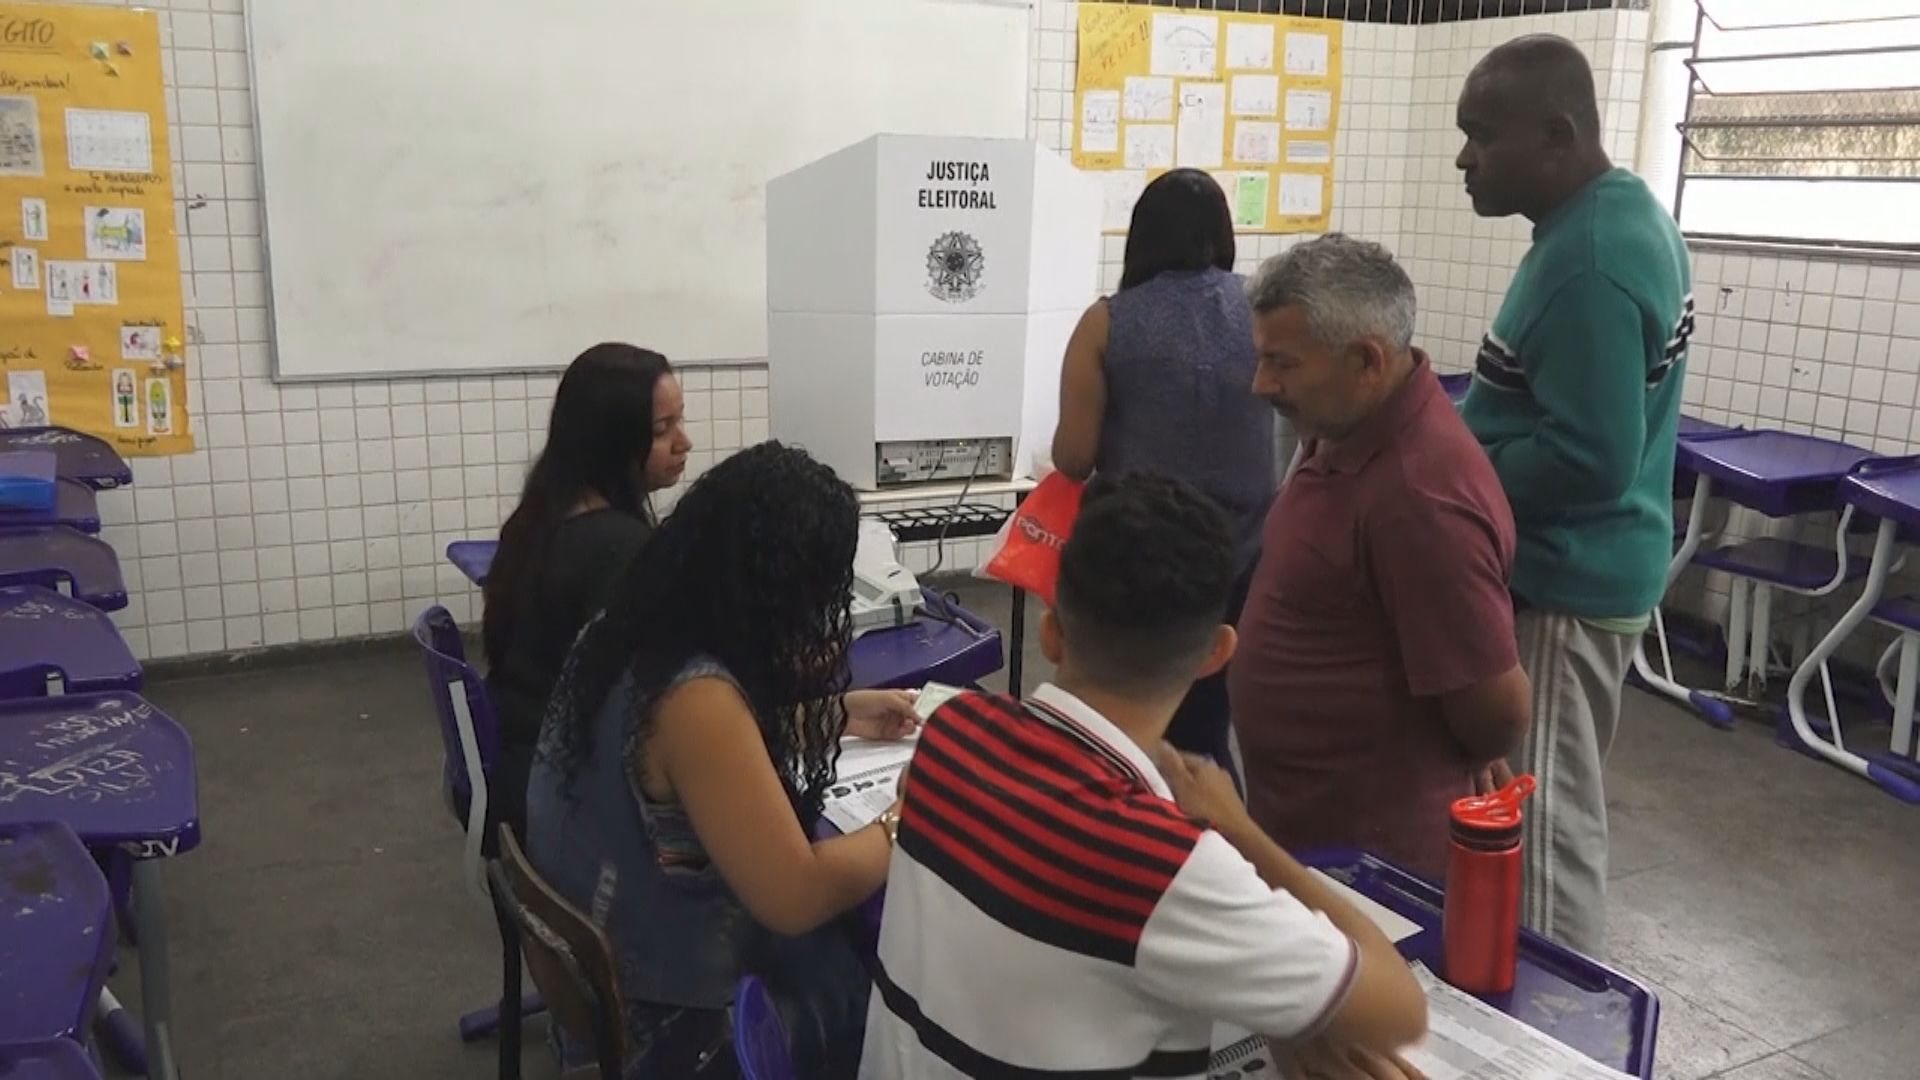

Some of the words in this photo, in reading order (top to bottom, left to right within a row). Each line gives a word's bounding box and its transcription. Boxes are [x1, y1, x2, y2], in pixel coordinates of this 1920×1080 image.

[927, 161, 990, 187] JUSTIÇA
[918, 188, 997, 209] ELEITORAL
[921, 350, 965, 367] CABINA
[967, 349, 985, 366] DE
[924, 367, 980, 390] VOTAÇÃO
